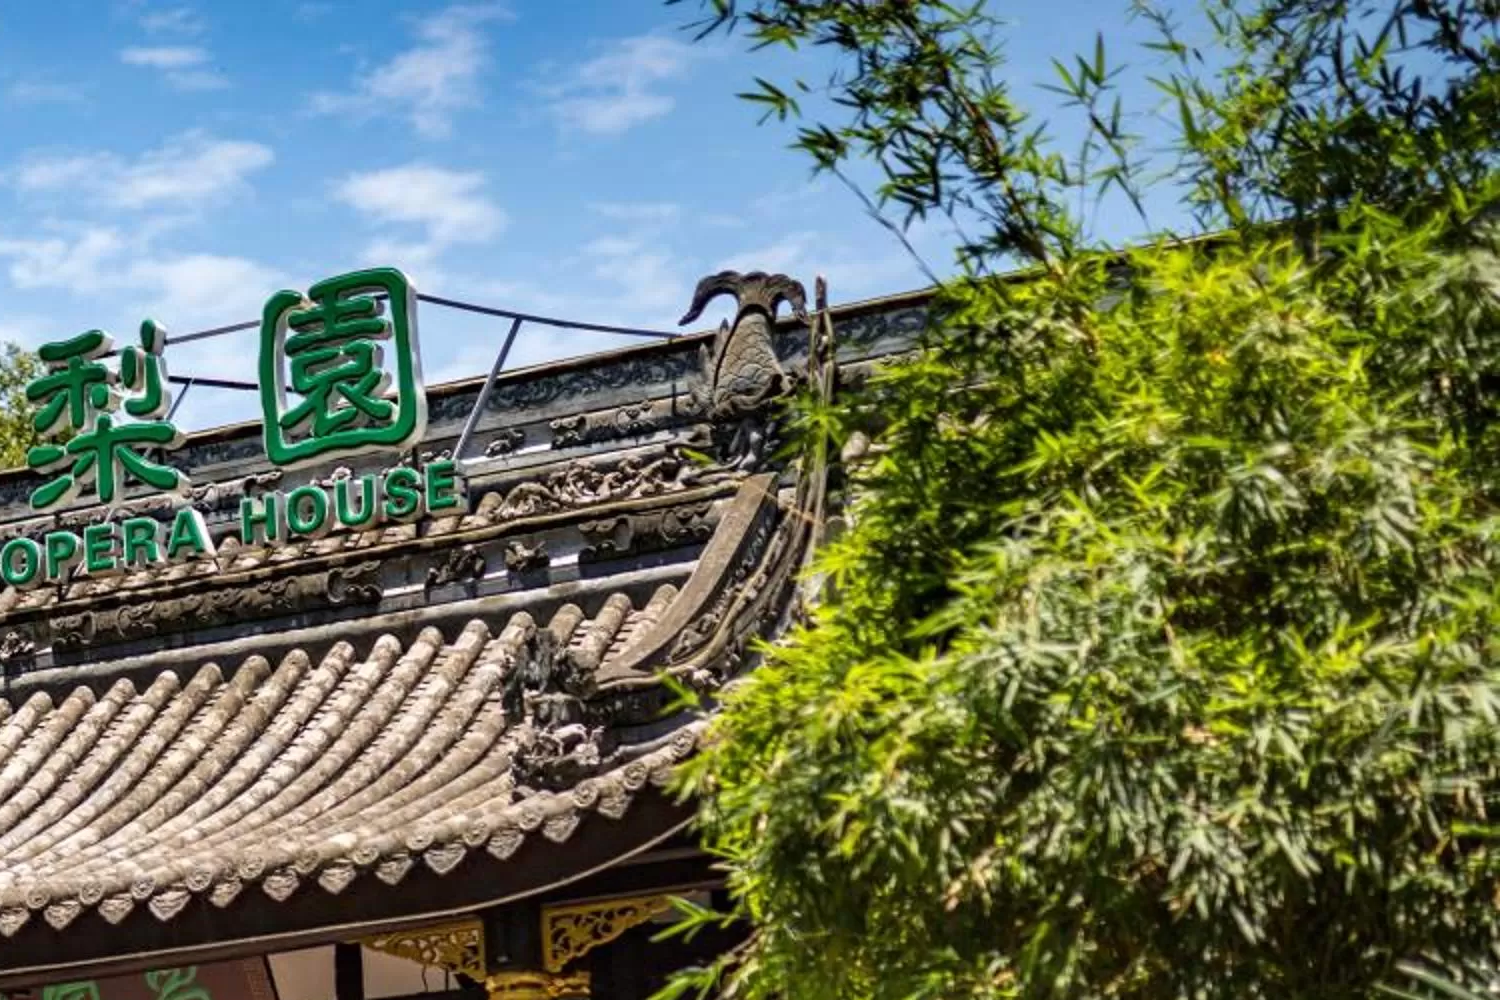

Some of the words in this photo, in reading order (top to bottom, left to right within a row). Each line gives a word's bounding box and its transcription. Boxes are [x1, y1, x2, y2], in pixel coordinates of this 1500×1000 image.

[25, 266, 420, 510] 梨園
[0, 506, 207, 587] OPERA
[240, 459, 461, 545] HOUSE
